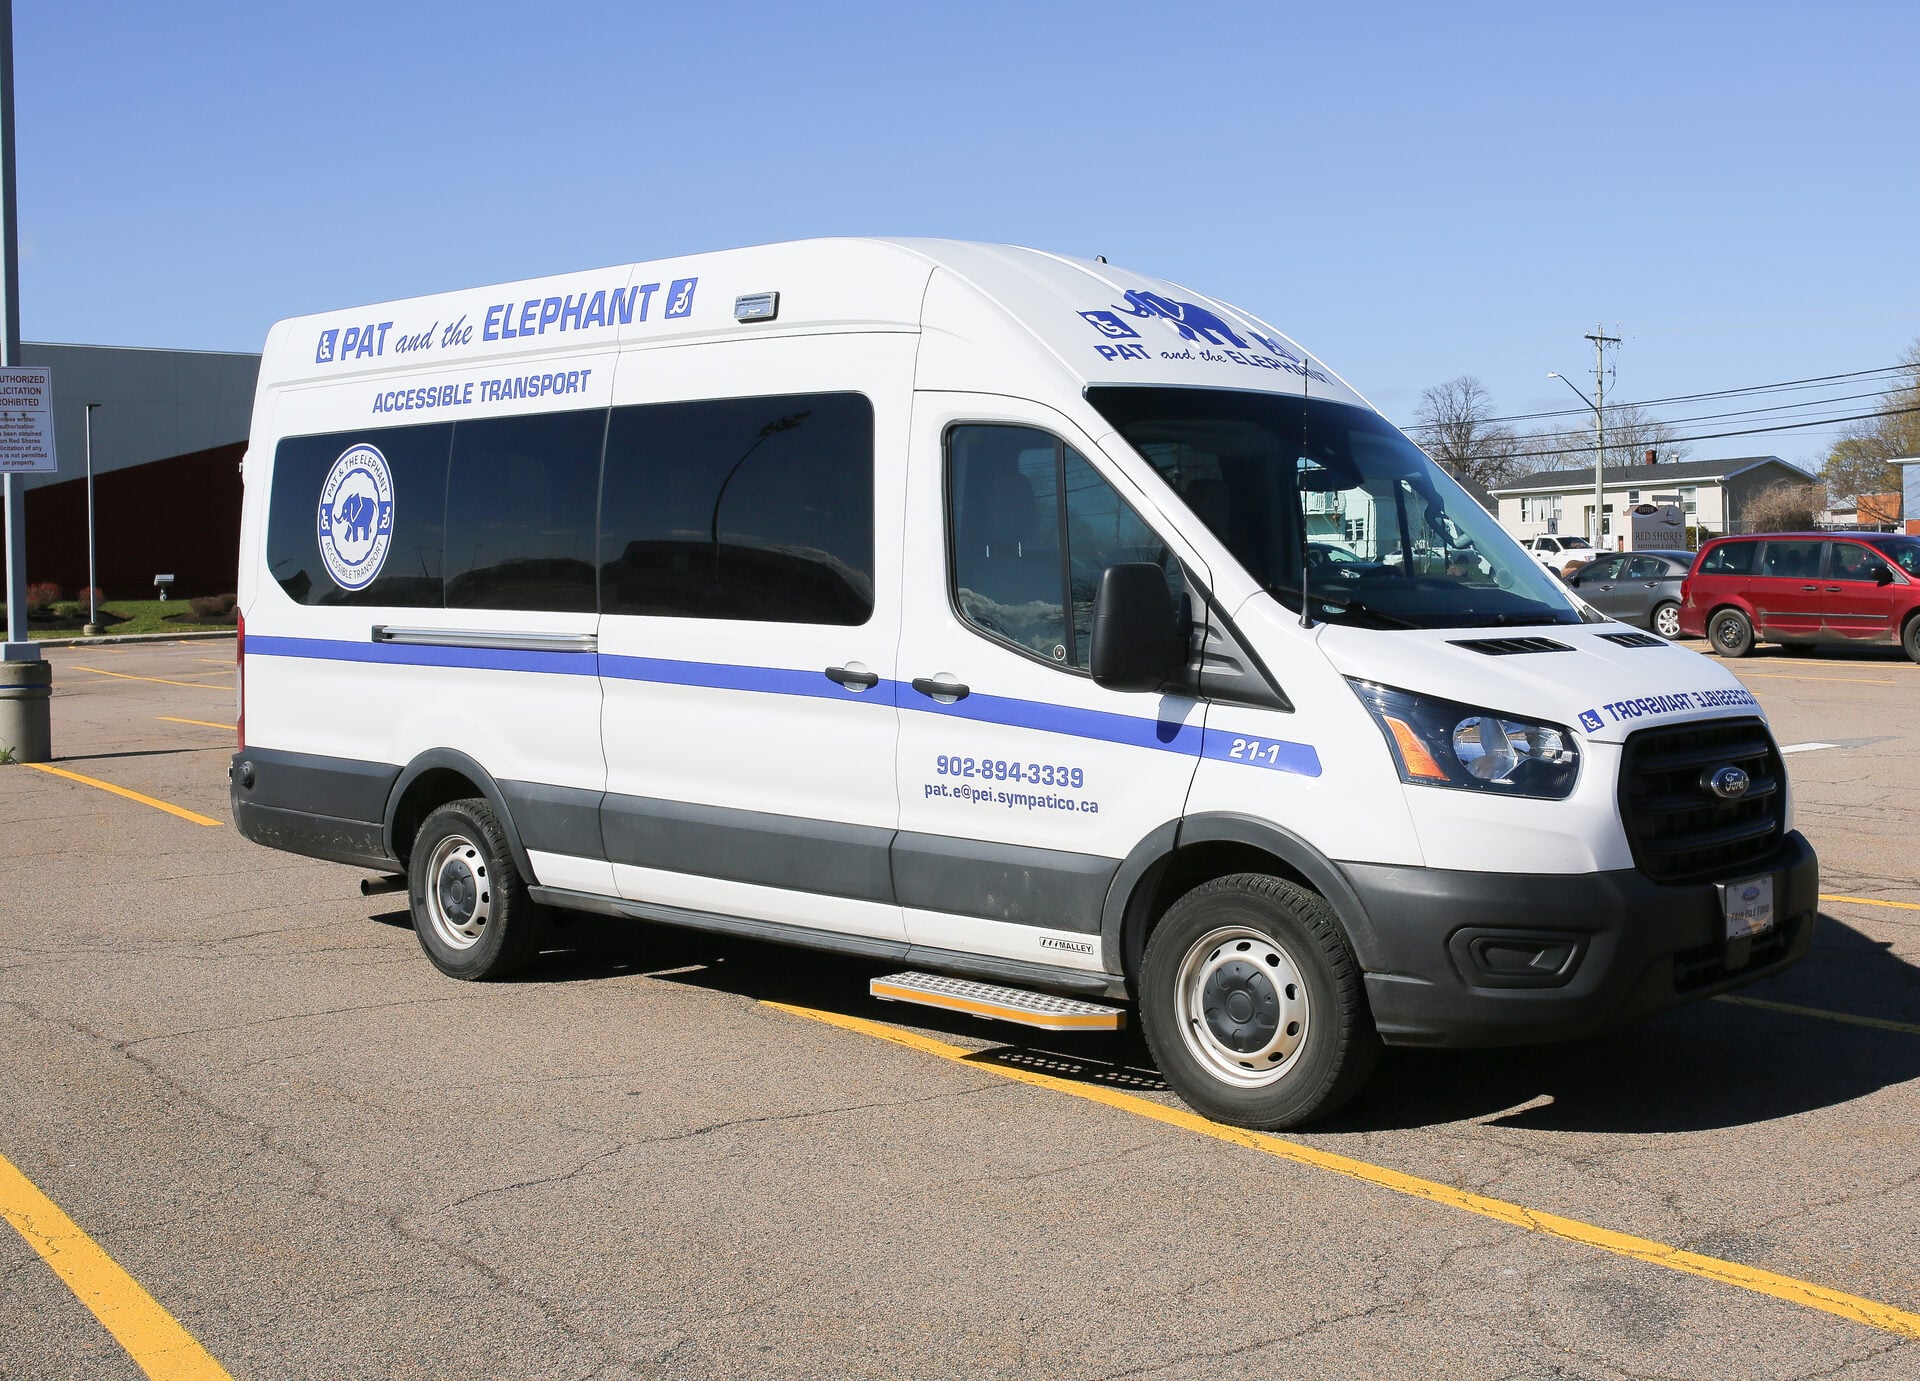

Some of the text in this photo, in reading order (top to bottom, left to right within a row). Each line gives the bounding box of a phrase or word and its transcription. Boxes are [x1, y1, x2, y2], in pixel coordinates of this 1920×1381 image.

[341, 283, 660, 361] PAT and the ELEPHANT
[1094, 343, 1152, 362] PAT
[1160, 349, 1196, 361] and
[1200, 348, 1227, 363] the
[372, 369, 592, 414] ACCESSIBLE TRANSPORT
[327, 454, 388, 497] PAT & THE ELEPHANT
[1635, 531, 1682, 544] RED SHORES
[326, 540, 383, 579] ACCESSIBLE TRANSPORT
[1229, 738, 1281, 765] 21-1
[936, 755, 1084, 789] 902-894-3339
[1726, 772, 1744, 792] Ford
[924, 781, 1099, 814] pat.e@pei.sympatico.ca
[1059, 942, 1091, 953] MALLEY
